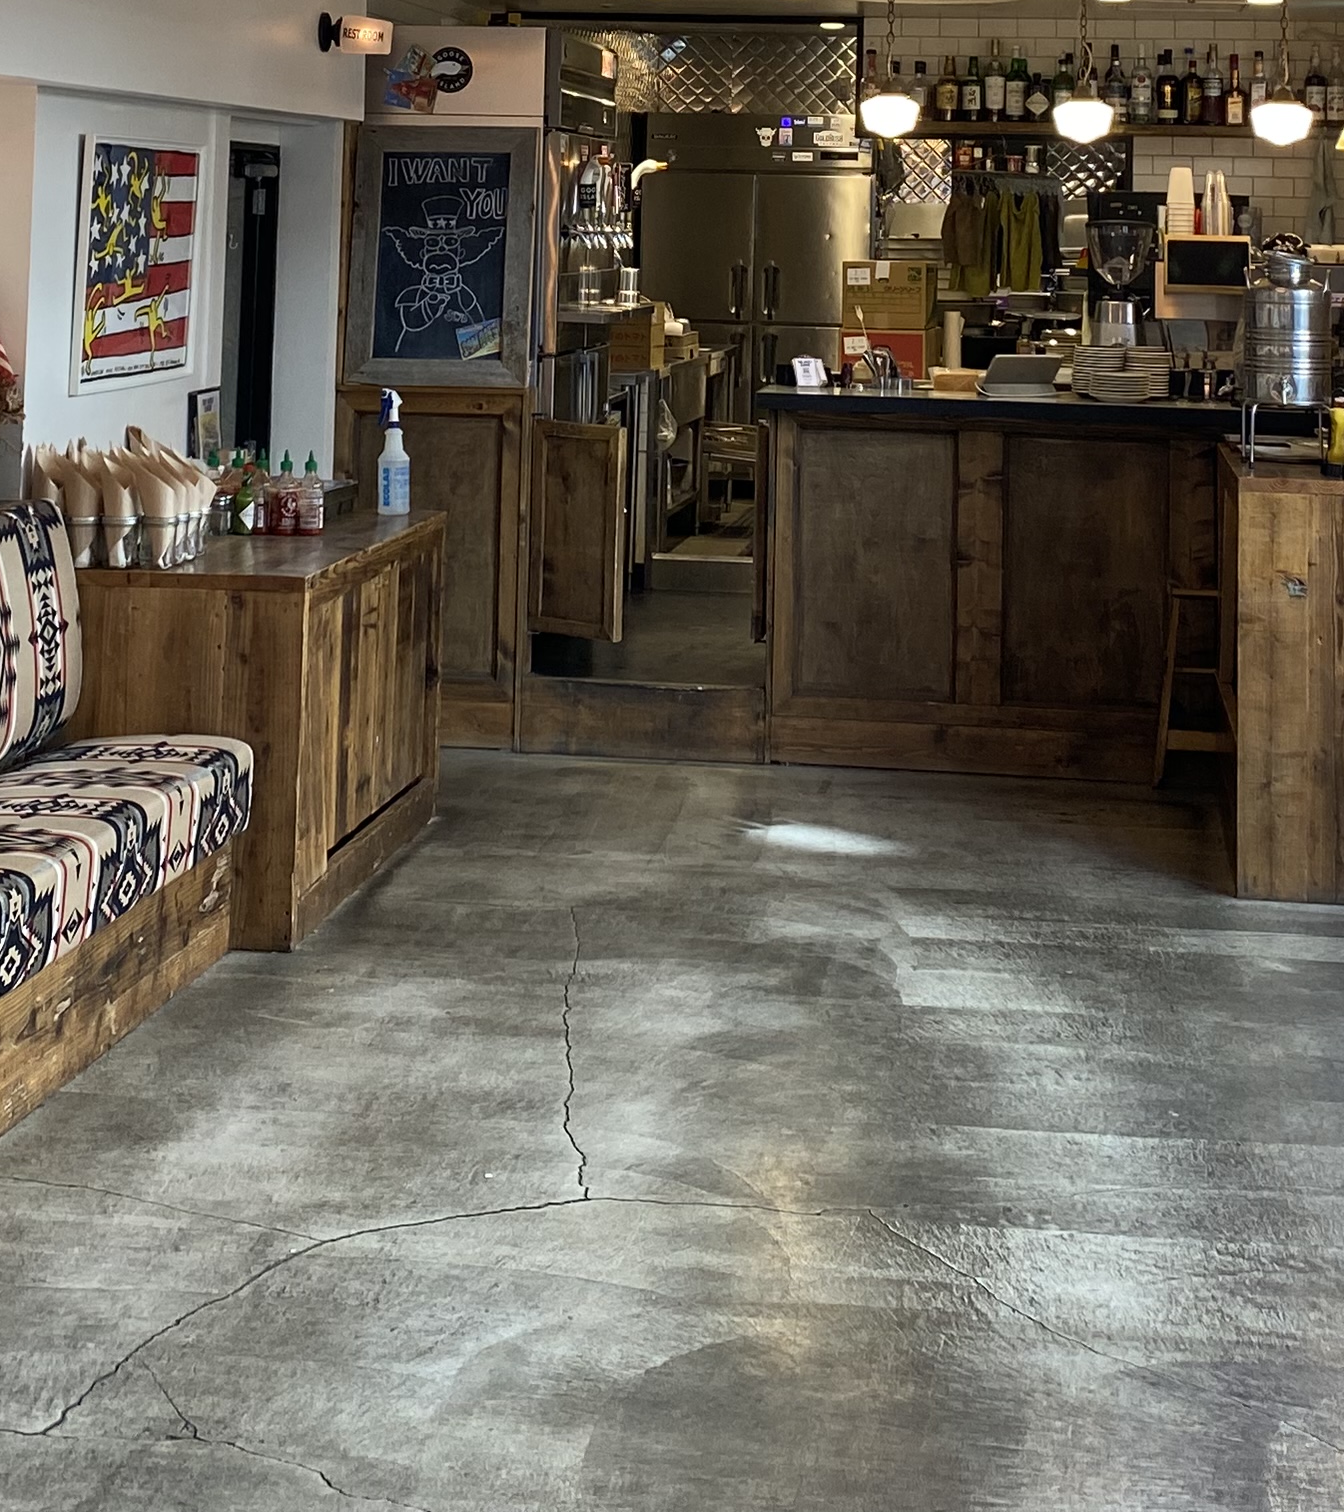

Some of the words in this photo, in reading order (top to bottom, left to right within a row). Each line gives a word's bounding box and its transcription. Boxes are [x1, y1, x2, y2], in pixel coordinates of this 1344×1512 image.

[342, 27, 360, 40] REST
[437, 51, 465, 62] GOOSE
[439, 78, 465, 89] SLAND
[388, 157, 398, 186] I
[400, 157, 493, 184] WANT
[459, 188, 507, 219] YOU
